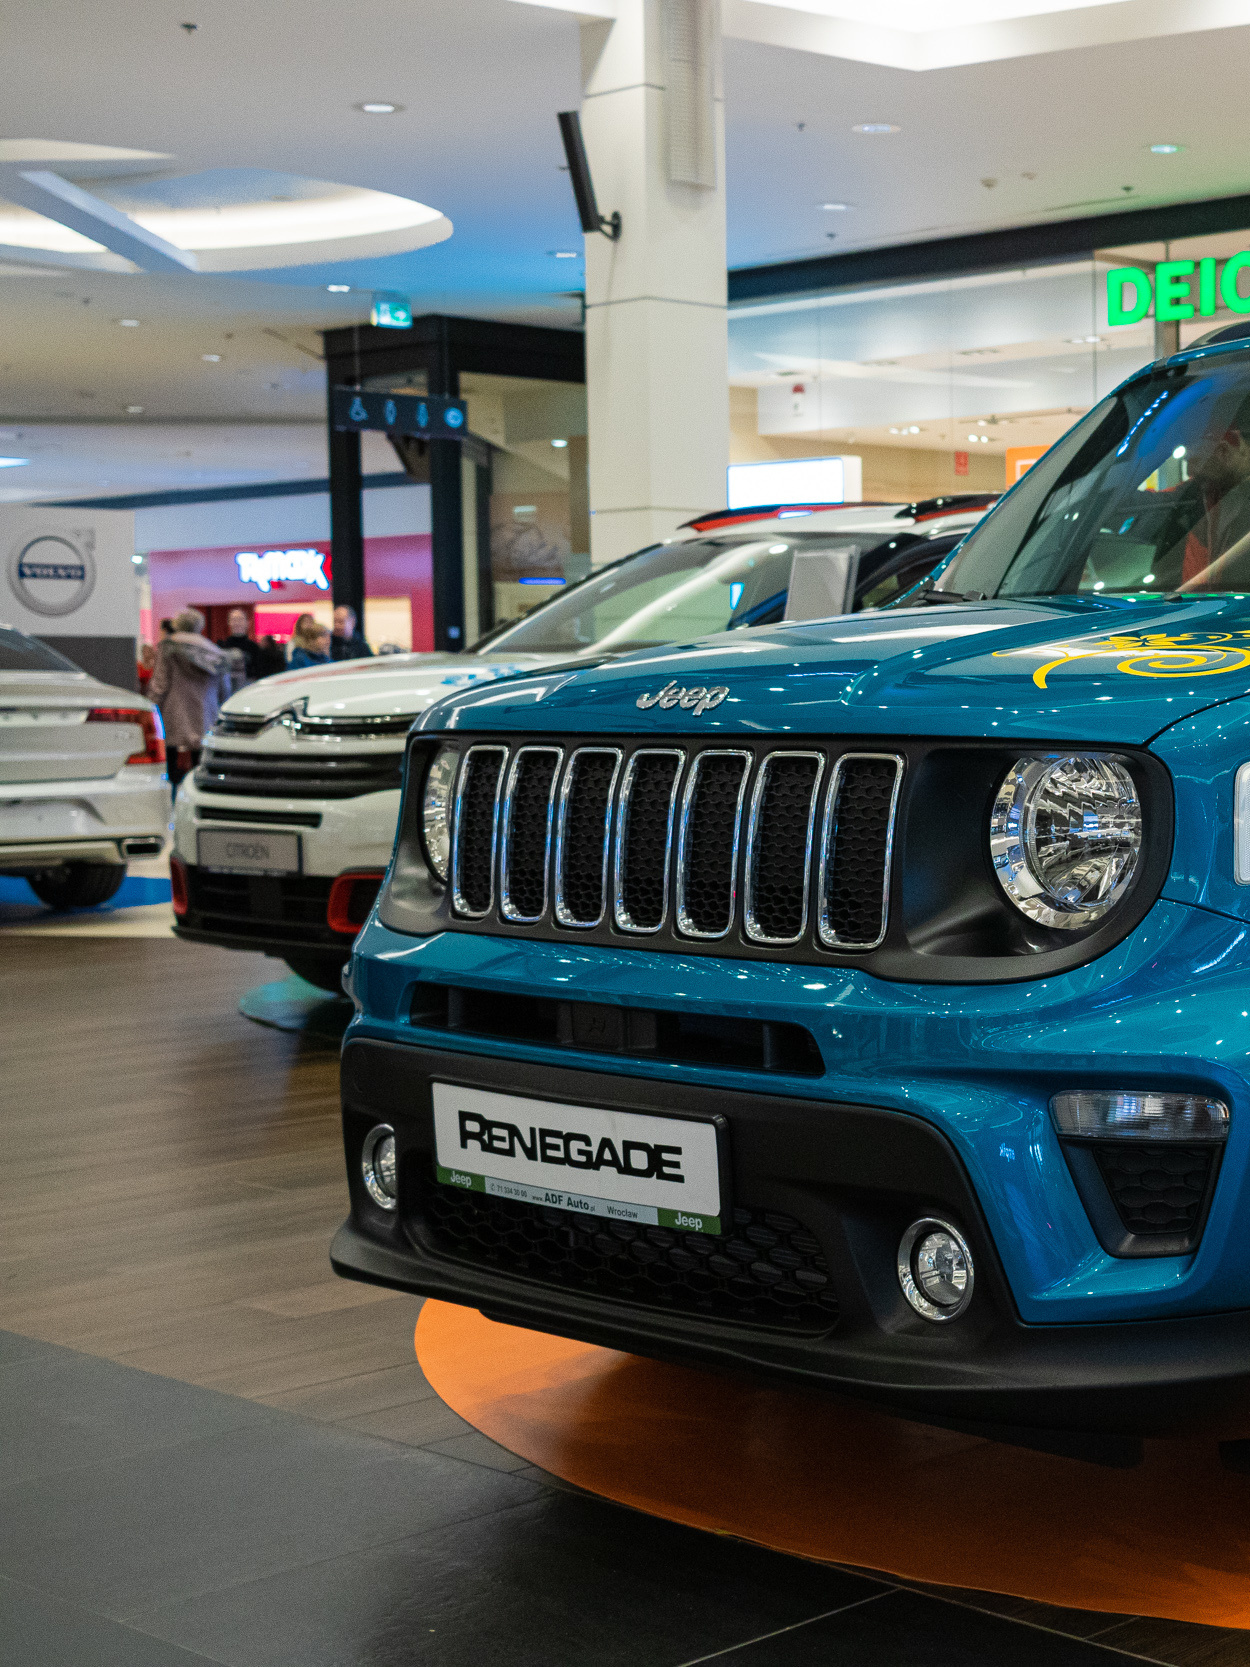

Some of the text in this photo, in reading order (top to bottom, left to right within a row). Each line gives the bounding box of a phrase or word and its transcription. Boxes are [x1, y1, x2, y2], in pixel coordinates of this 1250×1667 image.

[636, 680, 730, 716] Jeep
[458, 1110, 685, 1183] RENEGADE
[450, 1170, 472, 1188] Jeep
[544, 1192, 564, 1205] ADF
[675, 1212, 703, 1230] Jeep
